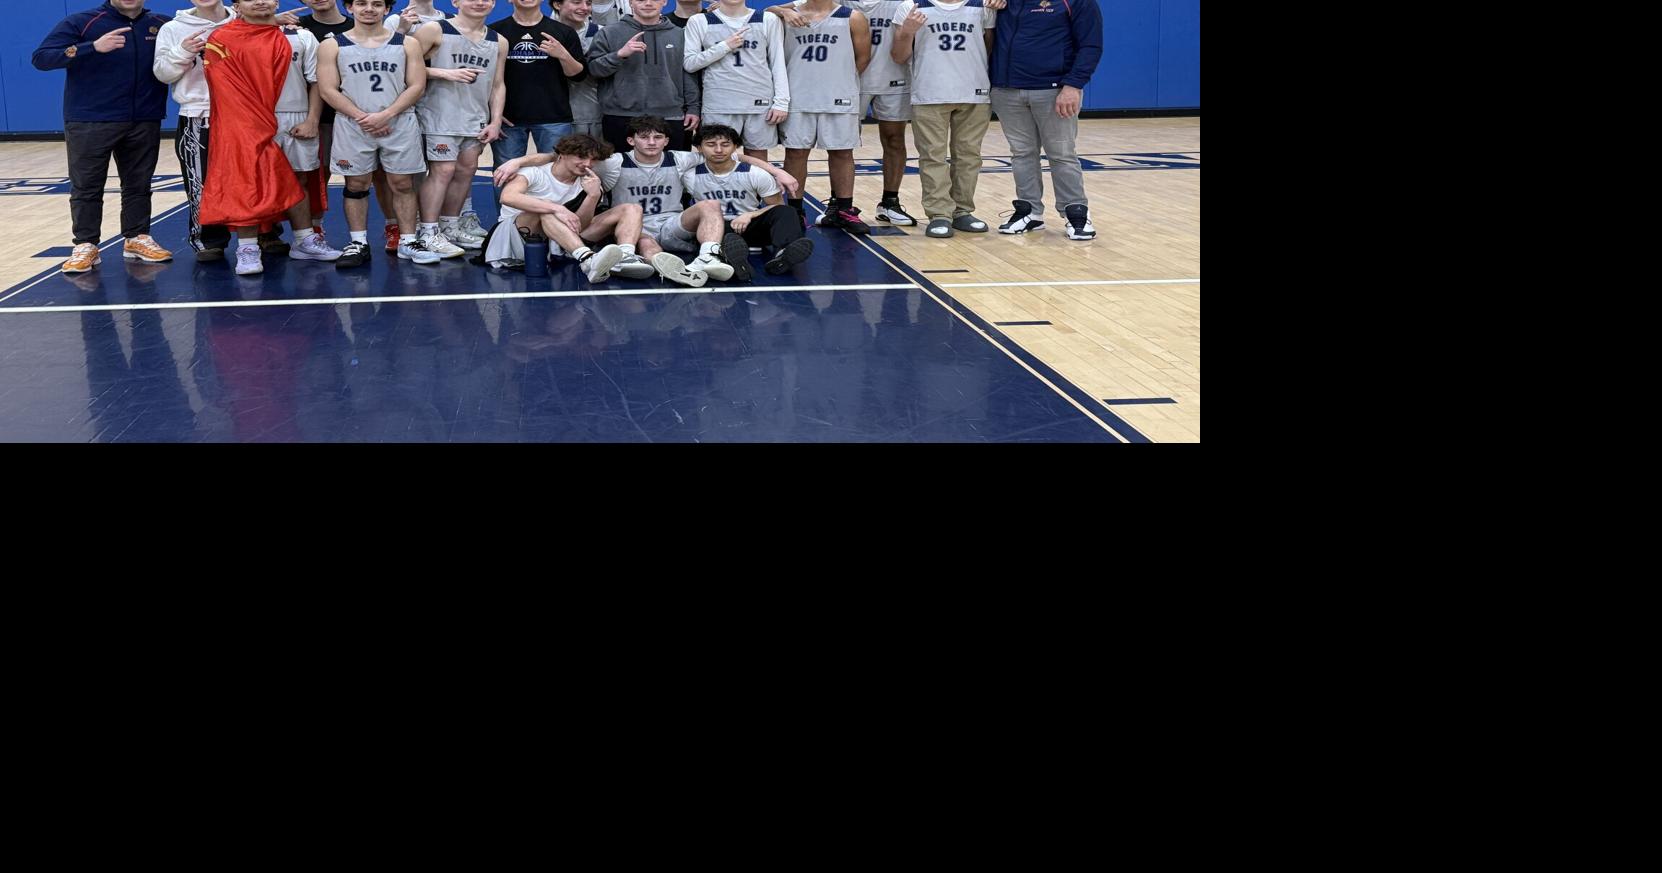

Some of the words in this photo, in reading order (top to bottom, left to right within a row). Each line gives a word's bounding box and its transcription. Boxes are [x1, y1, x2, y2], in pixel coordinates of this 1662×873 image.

[870, 17, 892, 28] ERS
[928, 22, 975, 33] TIGERS
[795, 33, 839, 45] TIGERS
[871, 29, 882, 45] 5
[938, 34, 966, 51] 32
[451, 53, 490, 68] TIGERS
[732, 50, 744, 67] 1
[801, 45, 828, 62] 40
[348, 61, 398, 73] TIGERS
[369, 73, 384, 92] 2
[627, 184, 672, 196] TIGERS
[703, 190, 748, 200] TIGERS
[638, 197, 662, 214] 13
